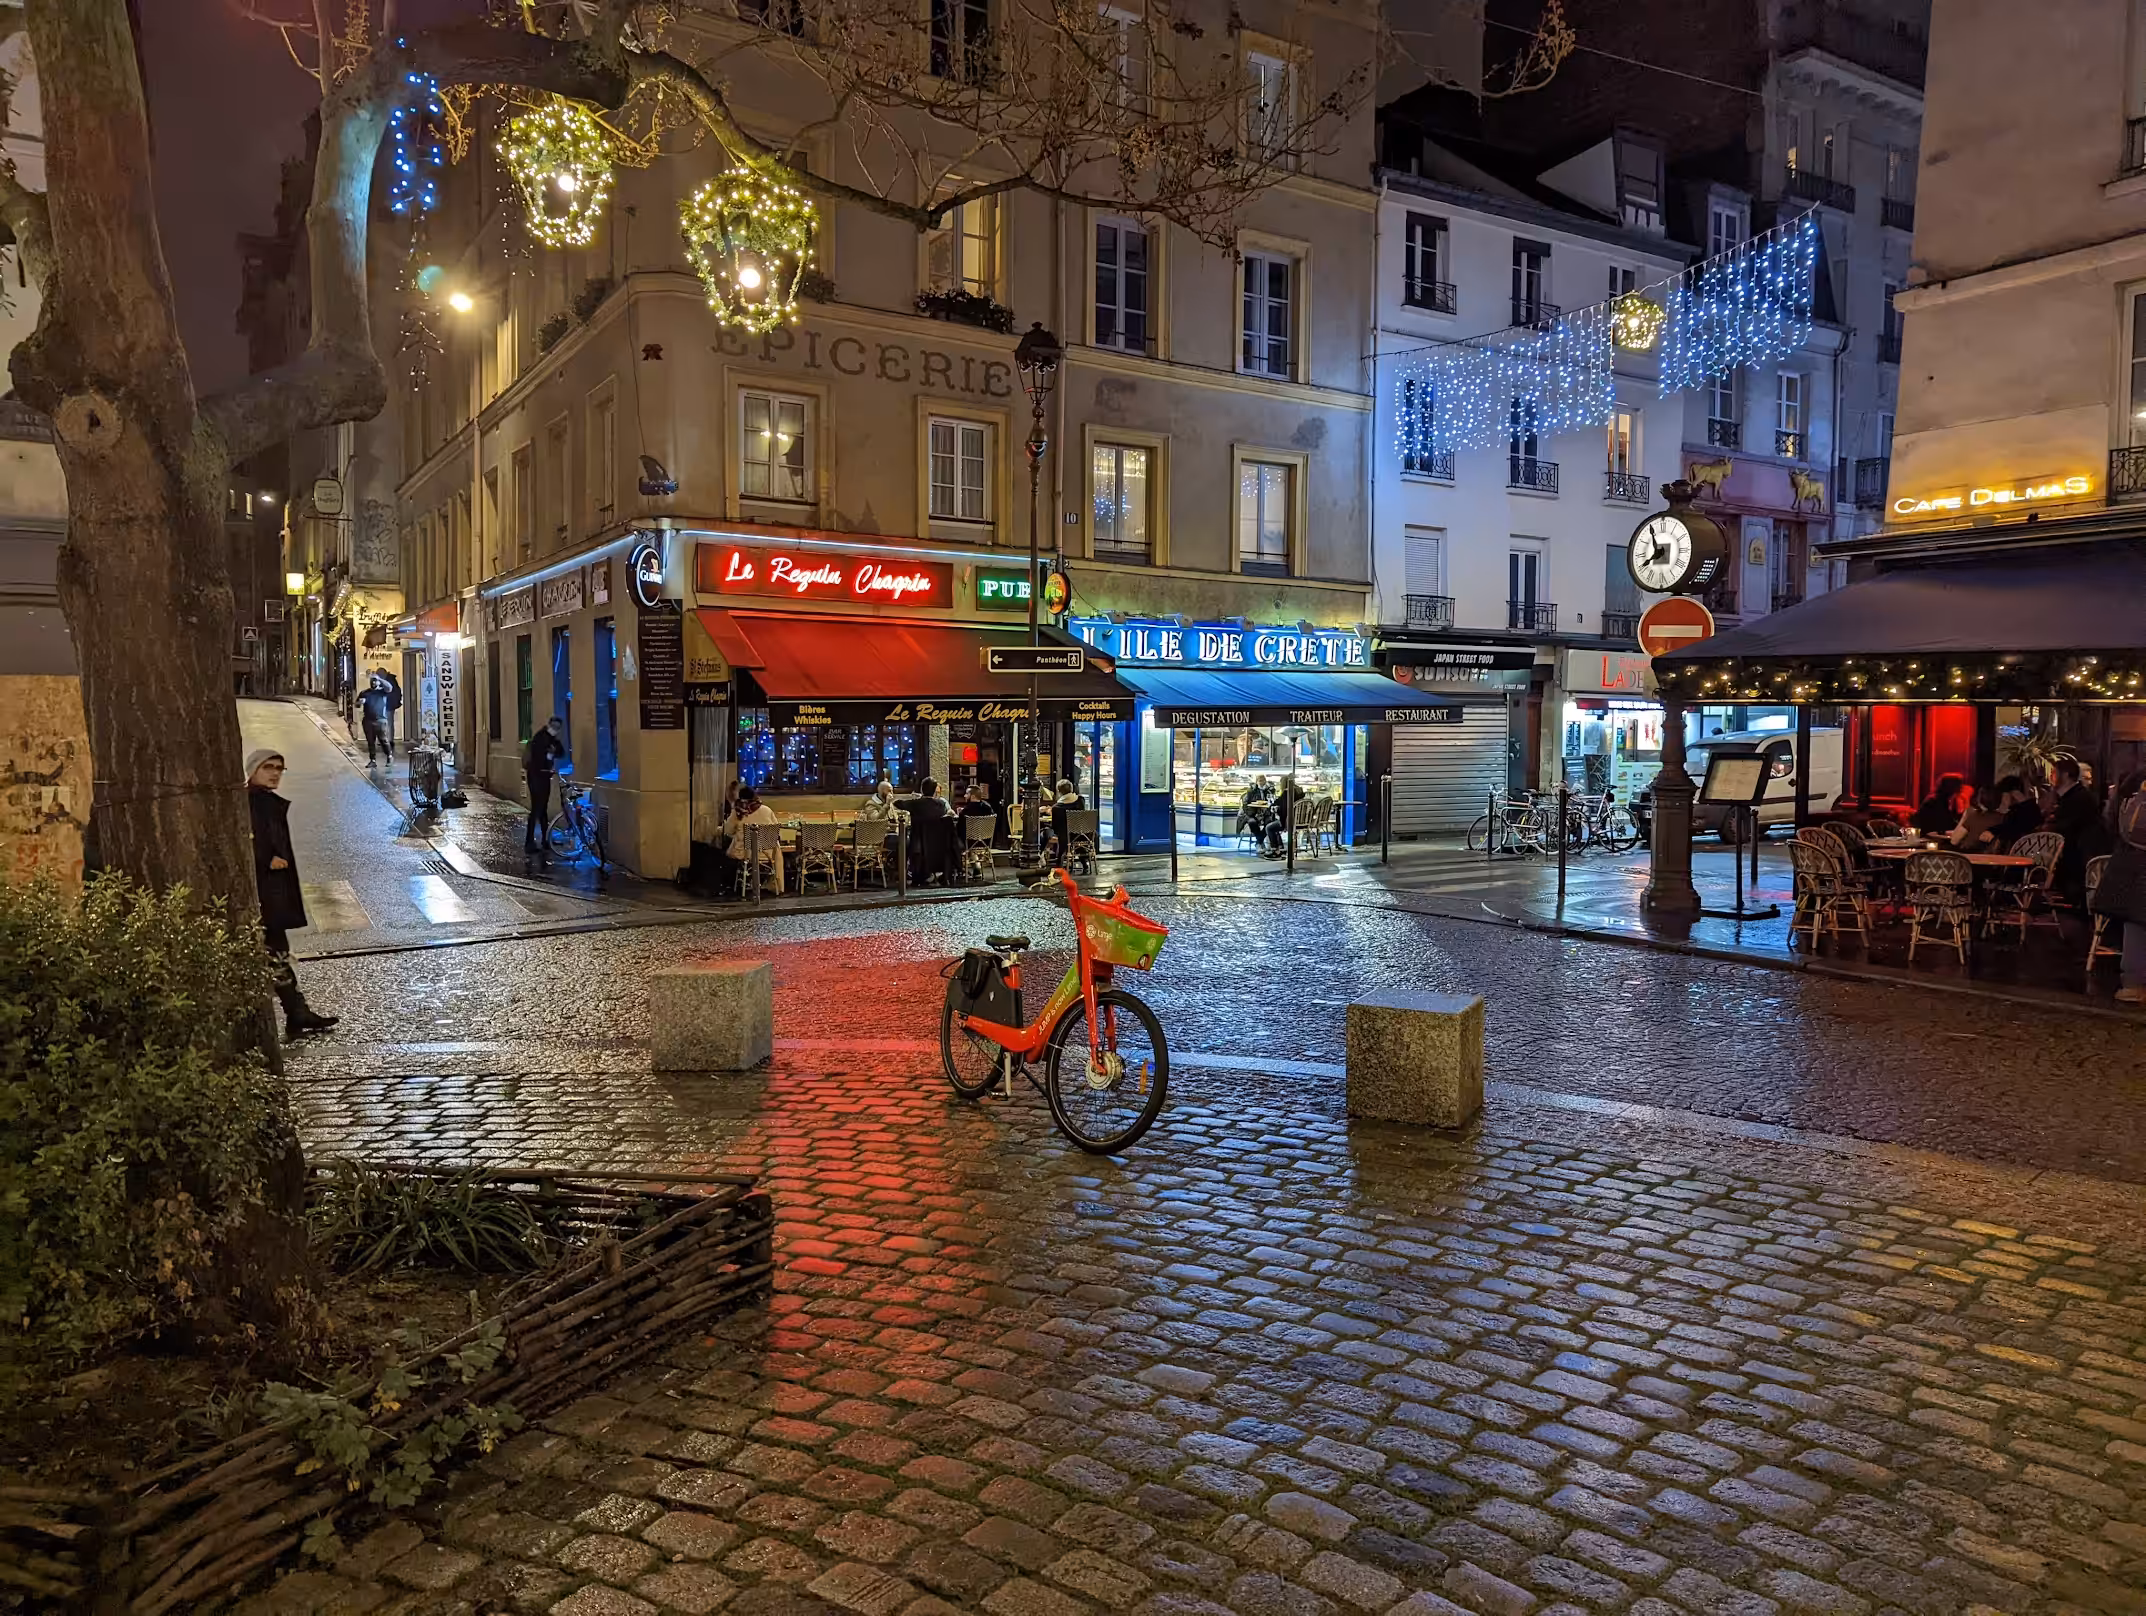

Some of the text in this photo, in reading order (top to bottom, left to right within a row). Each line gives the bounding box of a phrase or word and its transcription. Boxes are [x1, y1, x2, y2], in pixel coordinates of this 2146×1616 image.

[711, 328, 1012, 397] EPICERIE
[1066, 513, 1077, 524] 10
[725, 552, 931, 600] Le Requin Chagrin
[982, 580, 1031, 598] PUB
[1199, 632, 1243, 661] DE
[1036, 655, 1067, 664] Panthéon
[1434, 653, 1494, 664] JAPAN STREET FOOD
[440, 652, 456, 743] SANDWICHERIE
[799, 705, 826, 714] Bières
[1079, 701, 1110, 710] Cocktails
[793, 715, 832, 724] Whiskies
[884, 704, 910, 720] Le
[915, 704, 973, 724] Requin
[1072, 711, 1117, 721] Happy Hours
[1172, 709, 1449, 725] DEGUSTATION TRAITEUR RESTAURANT
[1872, 729, 1898, 741] unch
[1097, 930, 1113, 941] Lime
[1038, 1012, 1051, 1036] JUMP
[1054, 992, 1066, 1010] now
[1063, 976, 1077, 995] Lime
